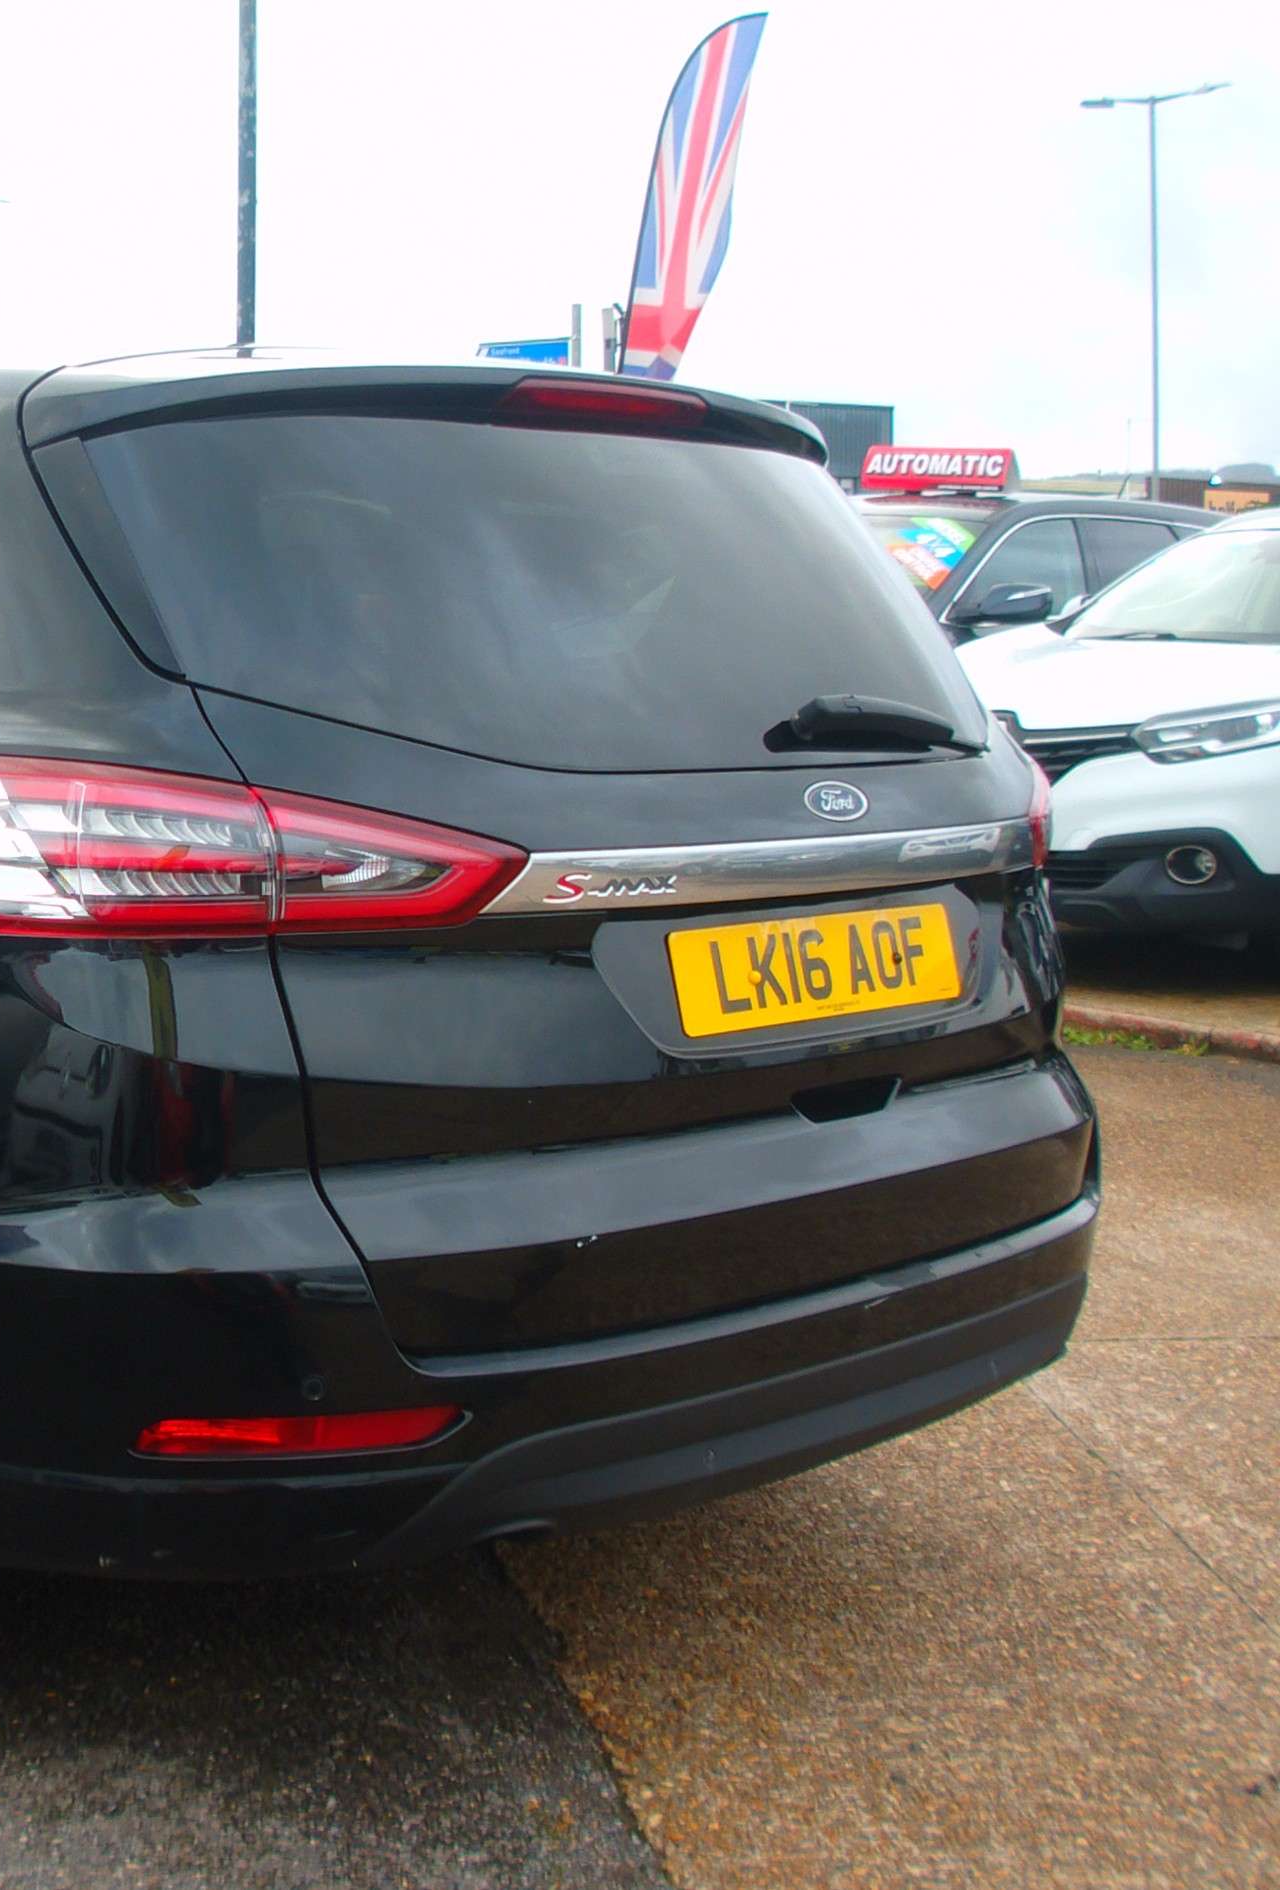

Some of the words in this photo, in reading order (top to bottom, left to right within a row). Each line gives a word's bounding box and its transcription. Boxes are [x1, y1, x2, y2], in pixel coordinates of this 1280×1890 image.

[866, 453, 1004, 477] AUTOMATIC
[820, 789, 855, 812] Ford
[542, 871, 678, 904] S-MAX
[708, 927, 833, 1014] LK16
[848, 916, 925, 995] AOF
